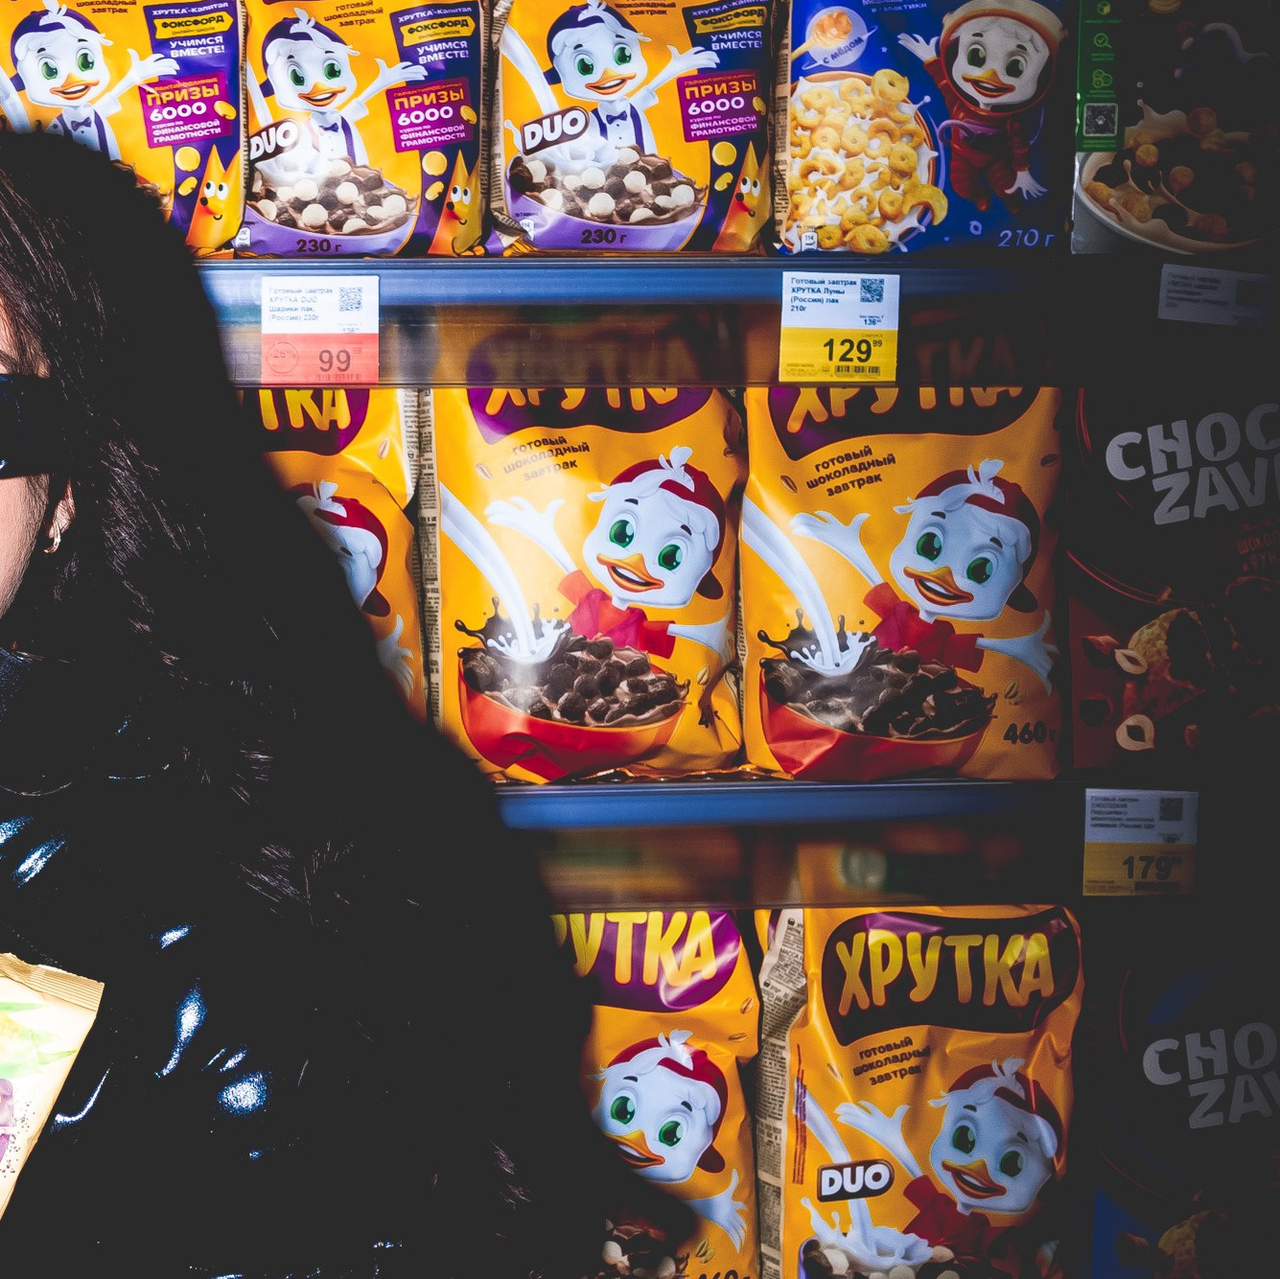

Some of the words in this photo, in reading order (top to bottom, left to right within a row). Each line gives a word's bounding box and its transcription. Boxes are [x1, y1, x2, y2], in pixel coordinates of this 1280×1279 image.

[323, 7, 383, 21] шоколадный
[336, 0, 373, 12] готовый
[161, 15, 224, 29] ФОКСФОРД
[338, 18, 376, 27] завтрак
[407, 19, 470, 35] ФОКСФОРД
[169, 36, 223, 48] УЧИМСЯ
[710, 31, 762, 42] УЧИМСЯ
[711, 39, 763, 50] ВМЕСТЕ!
[170, 45, 225, 58] ВМЕСТЕ!
[417, 40, 468, 56] УЧИМСЯ
[419, 50, 469, 63] ВМЕСТЕ!
[146, 84, 220, 106] ПРИЗЫ
[685, 80, 758, 100] ПРИЗЫ
[394, 89, 464, 111] ПРИЗЫ
[688, 96, 745, 115] 6000
[150, 101, 207, 122] 6000
[397, 106, 453, 126] 6000
[153, 119, 220, 136] ФИНАНСОВОЙ
[524, 109, 586, 150] DUO
[690, 114, 756, 129] ФИНАНСОВОЙ
[691, 123, 758, 137] ГРАМОТНОСТИ
[153, 127, 221, 143] ГРАМОТНОСТИ
[400, 124, 465, 139] ФИНАНСОВОЙ
[401, 131, 466, 148] ГРАМОТНОСТИ
[250, 122, 299, 161] DUO
[581, 228, 617, 244] 230
[998, 227, 1037, 249] 210
[296, 239, 331, 252] 230
[823, 338, 872, 362] 129
[319, 349, 351, 372] 99
[815, 445, 873, 472] готовый
[806, 453, 896, 489] шоколадный
[827, 472, 882, 497] завтрак
[1123, 855, 1172, 880] 179
[836, 927, 1054, 1017] ХРУТКА
[859, 1036, 914, 1060] готовый
[820, 1164, 890, 1196] DUO
